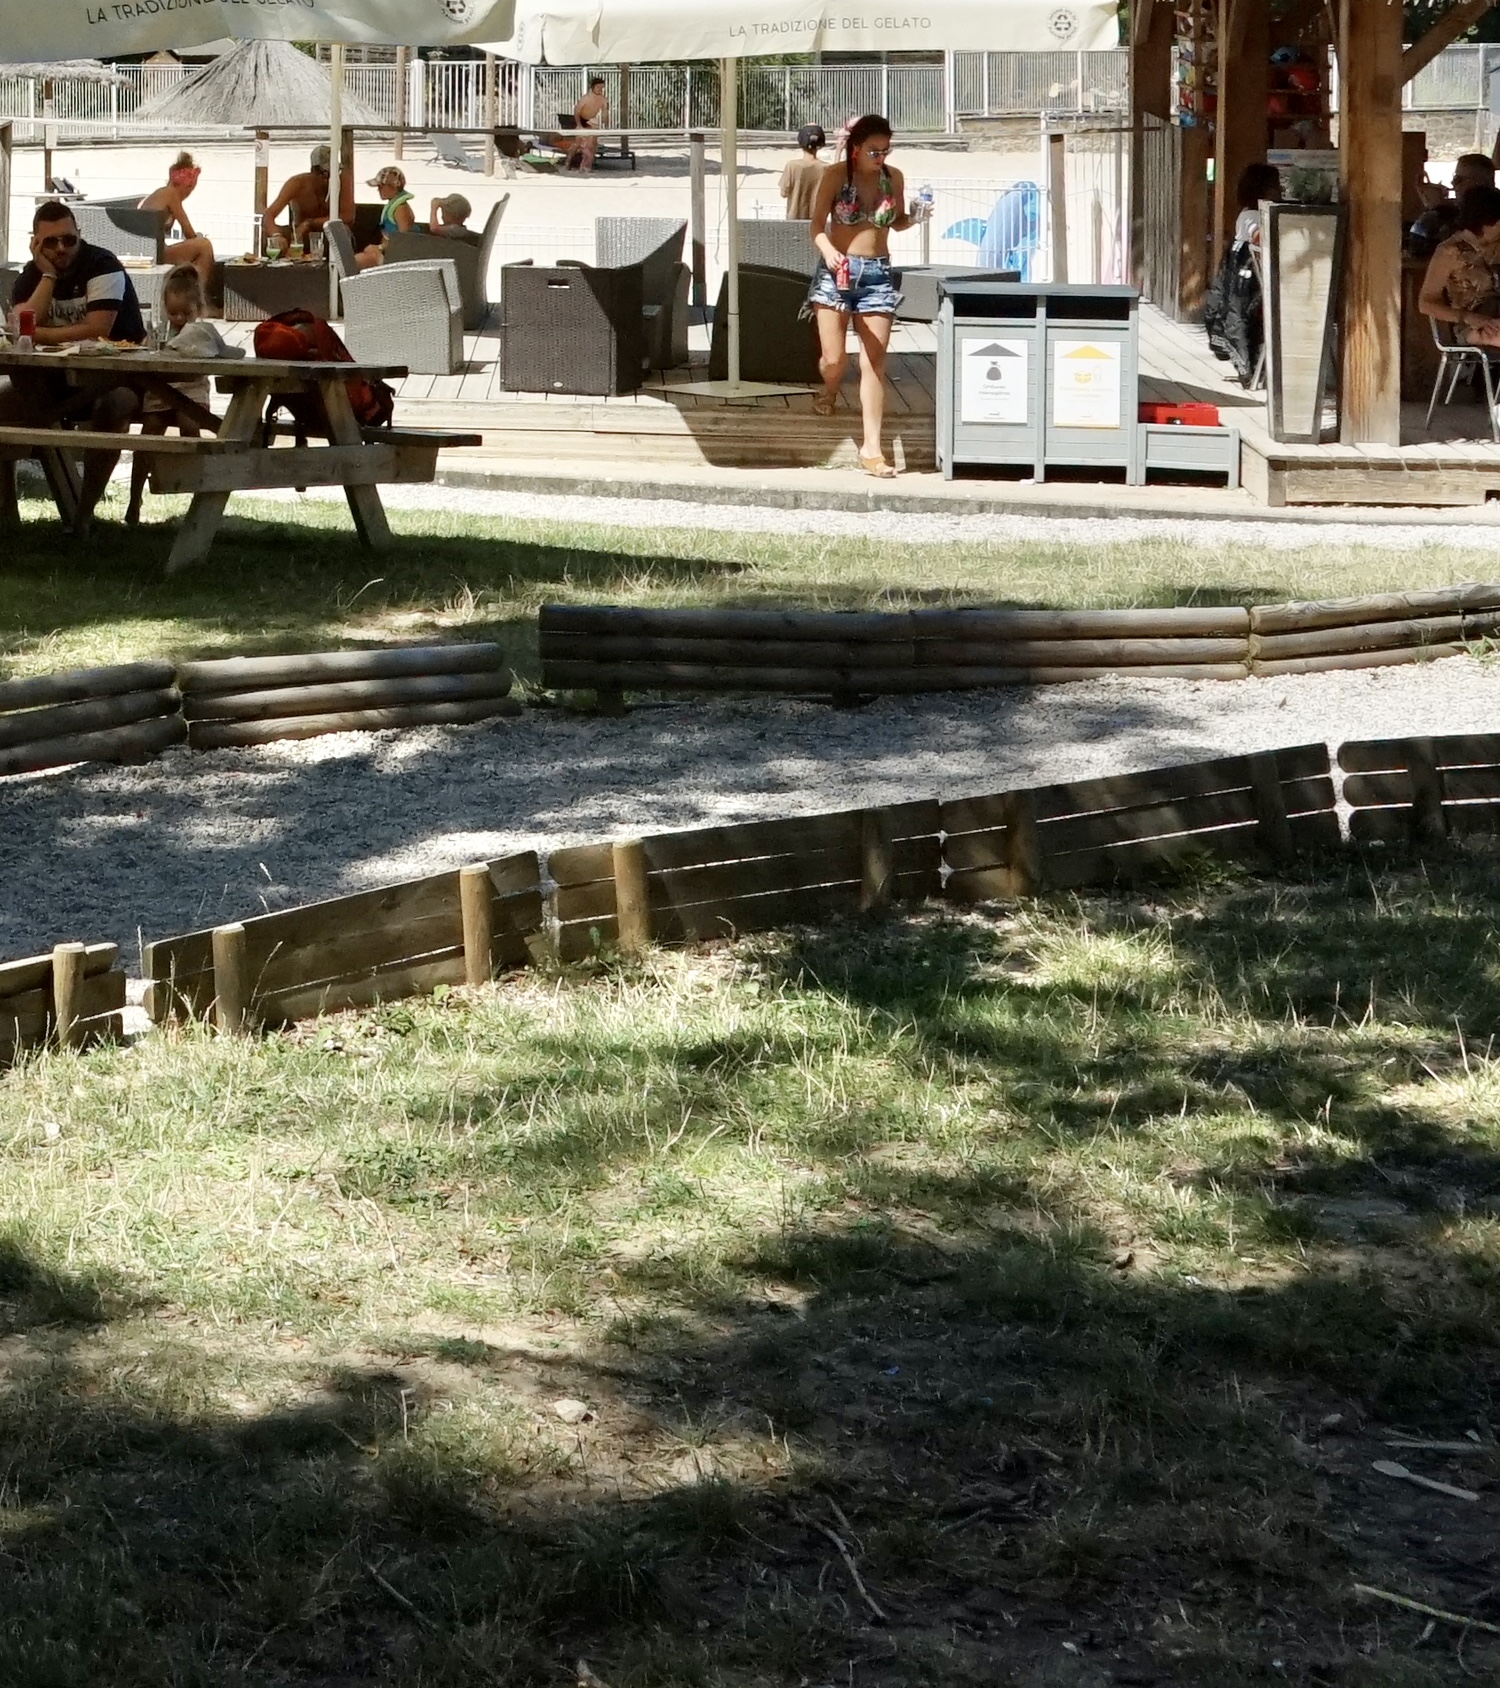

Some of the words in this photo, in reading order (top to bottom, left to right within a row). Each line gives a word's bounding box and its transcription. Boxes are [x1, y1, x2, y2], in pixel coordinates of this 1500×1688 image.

[86, 7, 108, 25] LA
[729, 26, 746, 37] LA
[753, 18, 836, 35] TRADIZIONE
[842, 18, 868, 29] DEL
[874, 17, 931, 29] GELATO
